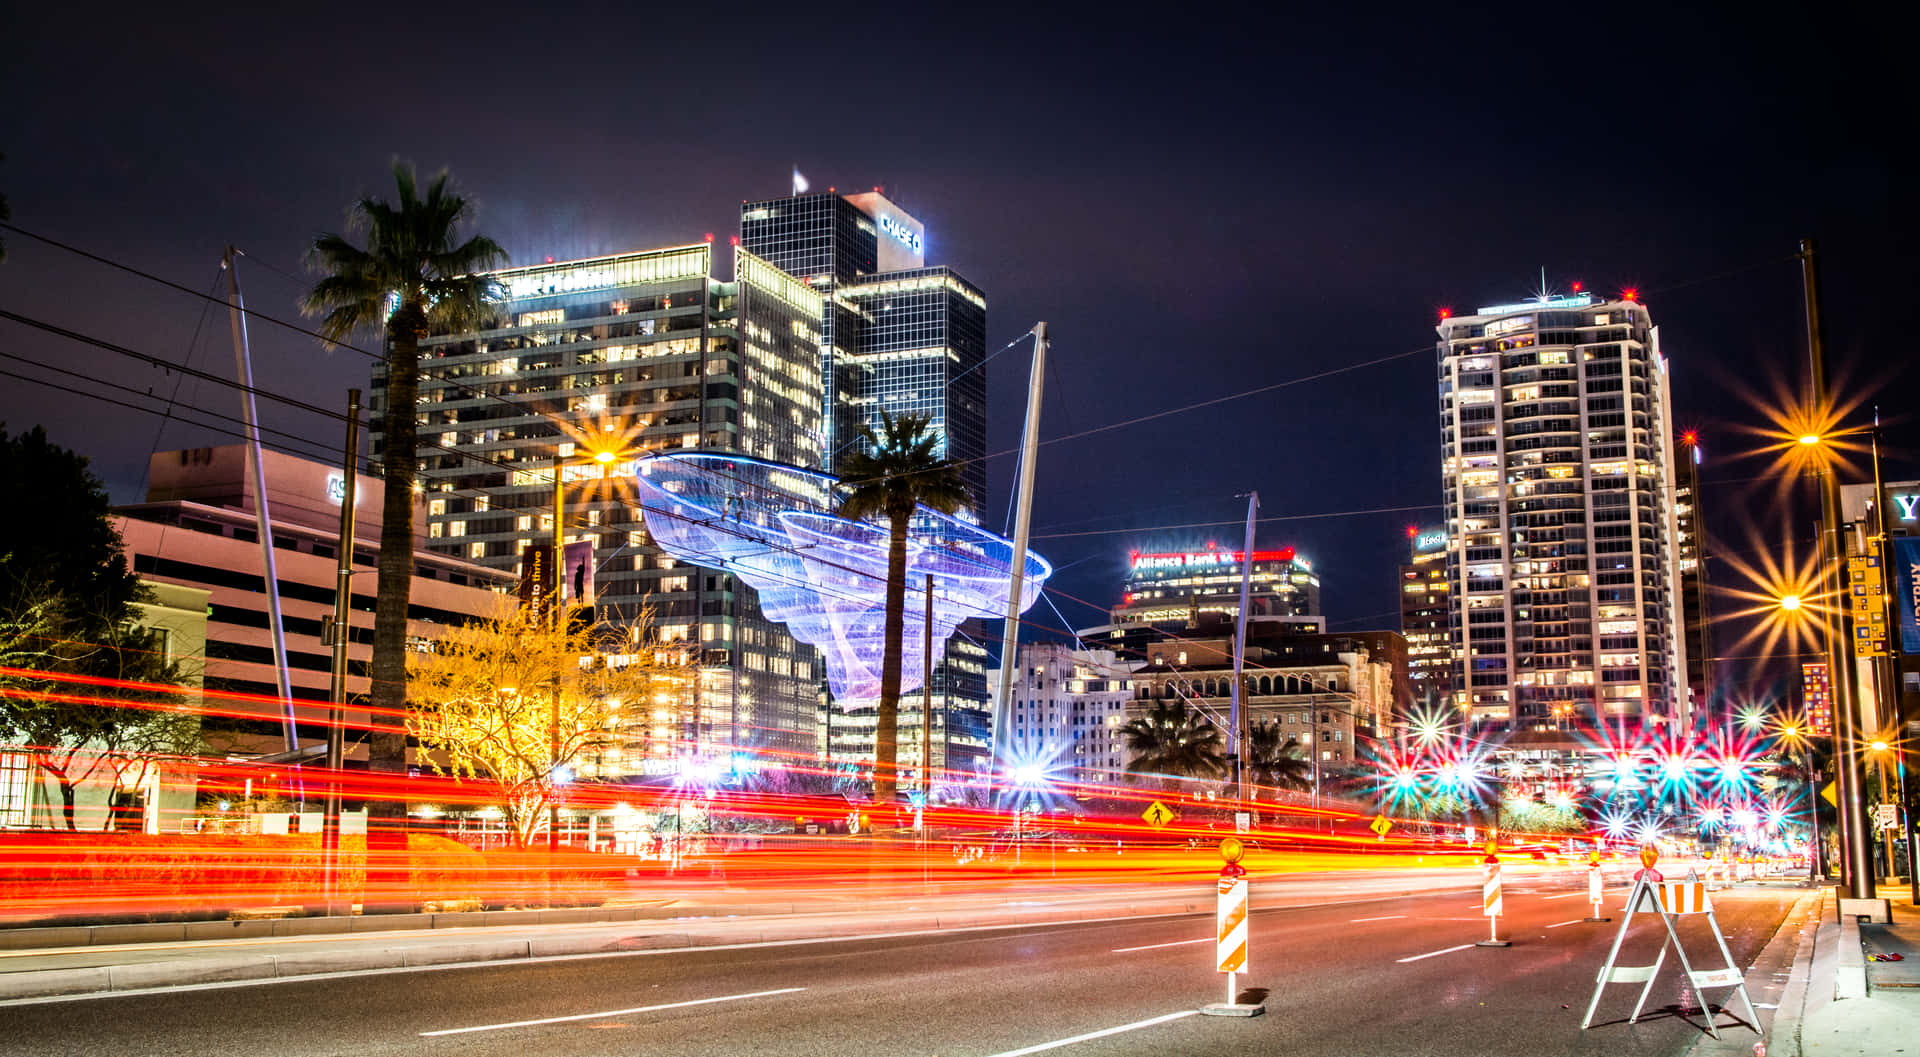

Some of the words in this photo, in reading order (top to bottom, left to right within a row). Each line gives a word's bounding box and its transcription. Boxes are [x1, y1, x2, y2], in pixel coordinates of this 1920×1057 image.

[880, 214, 913, 249] CHASE
[532, 551, 542, 581] thrive
[1135, 557, 1182, 569] Alliance
[1185, 553, 1217, 566] Bank
[531, 584, 541, 596] to
